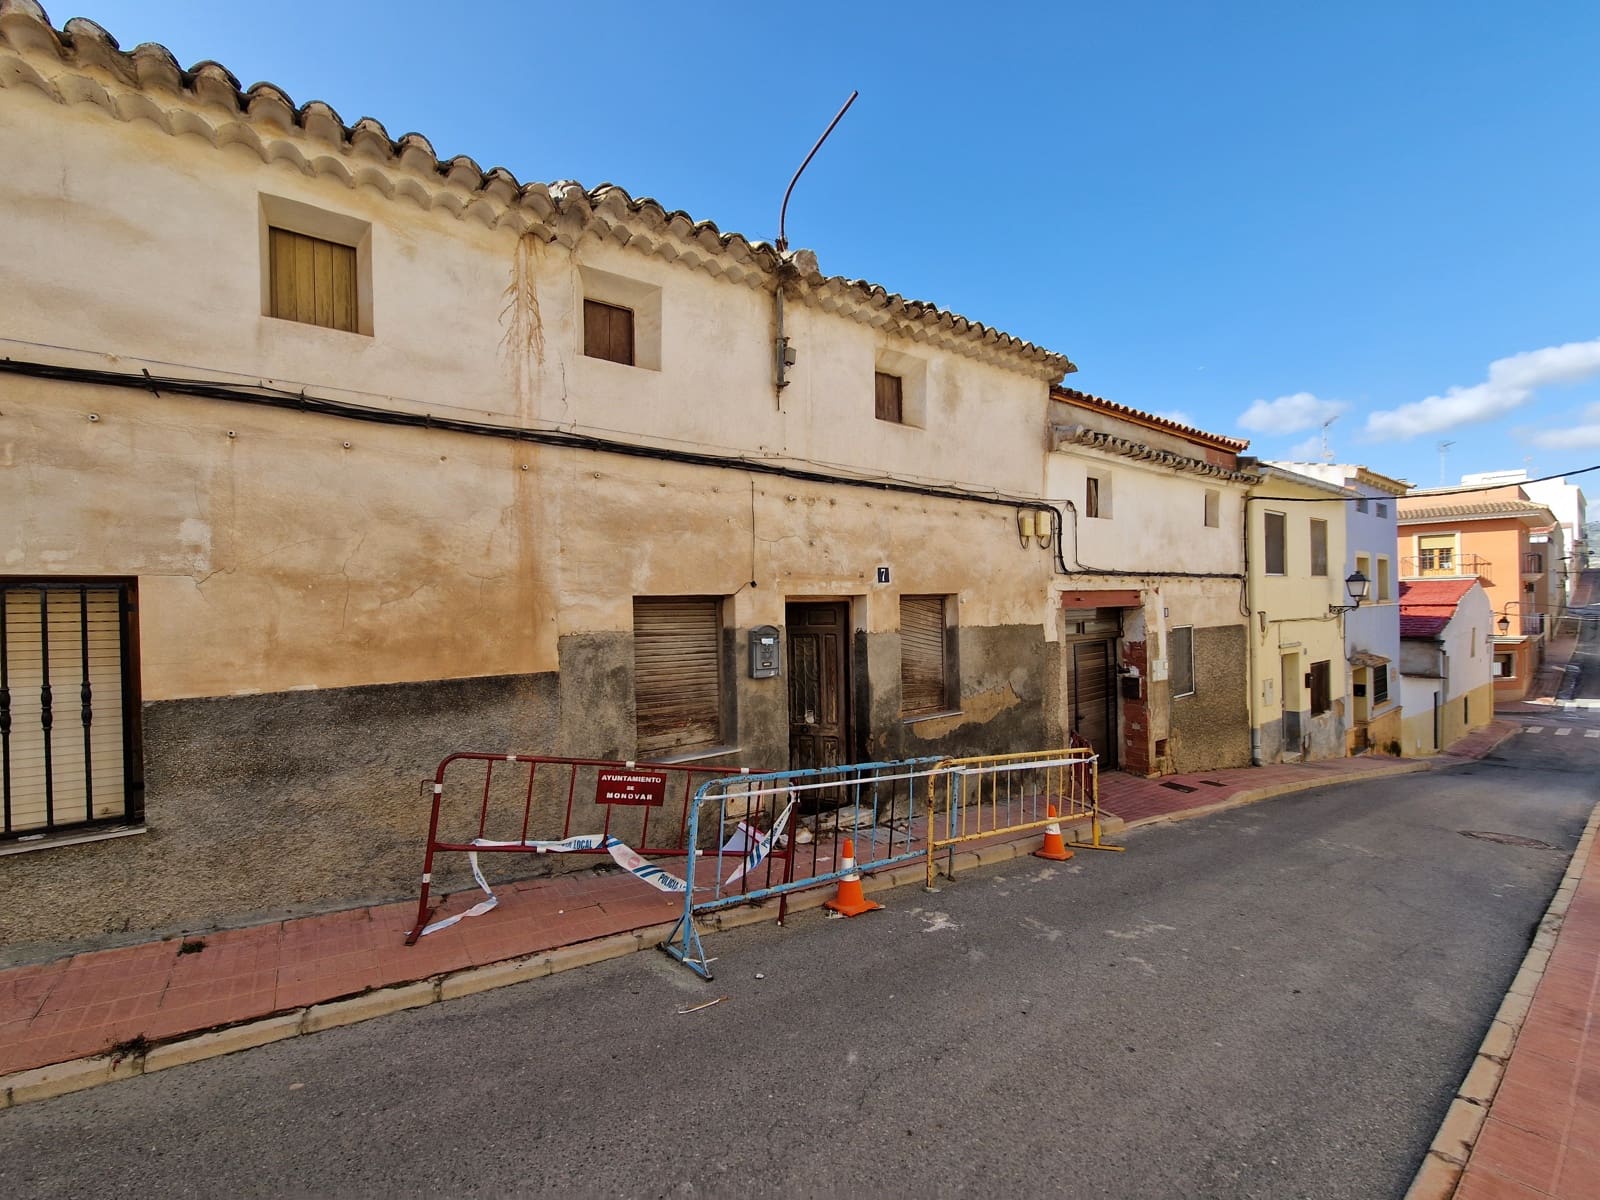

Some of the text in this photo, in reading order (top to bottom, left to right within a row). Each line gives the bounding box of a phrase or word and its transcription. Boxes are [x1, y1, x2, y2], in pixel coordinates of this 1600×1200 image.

[601, 774, 662, 784] AYUNTAMIENTO
[606, 792, 653, 801] MONOVAR
[573, 839, 593, 850] LOCAL
